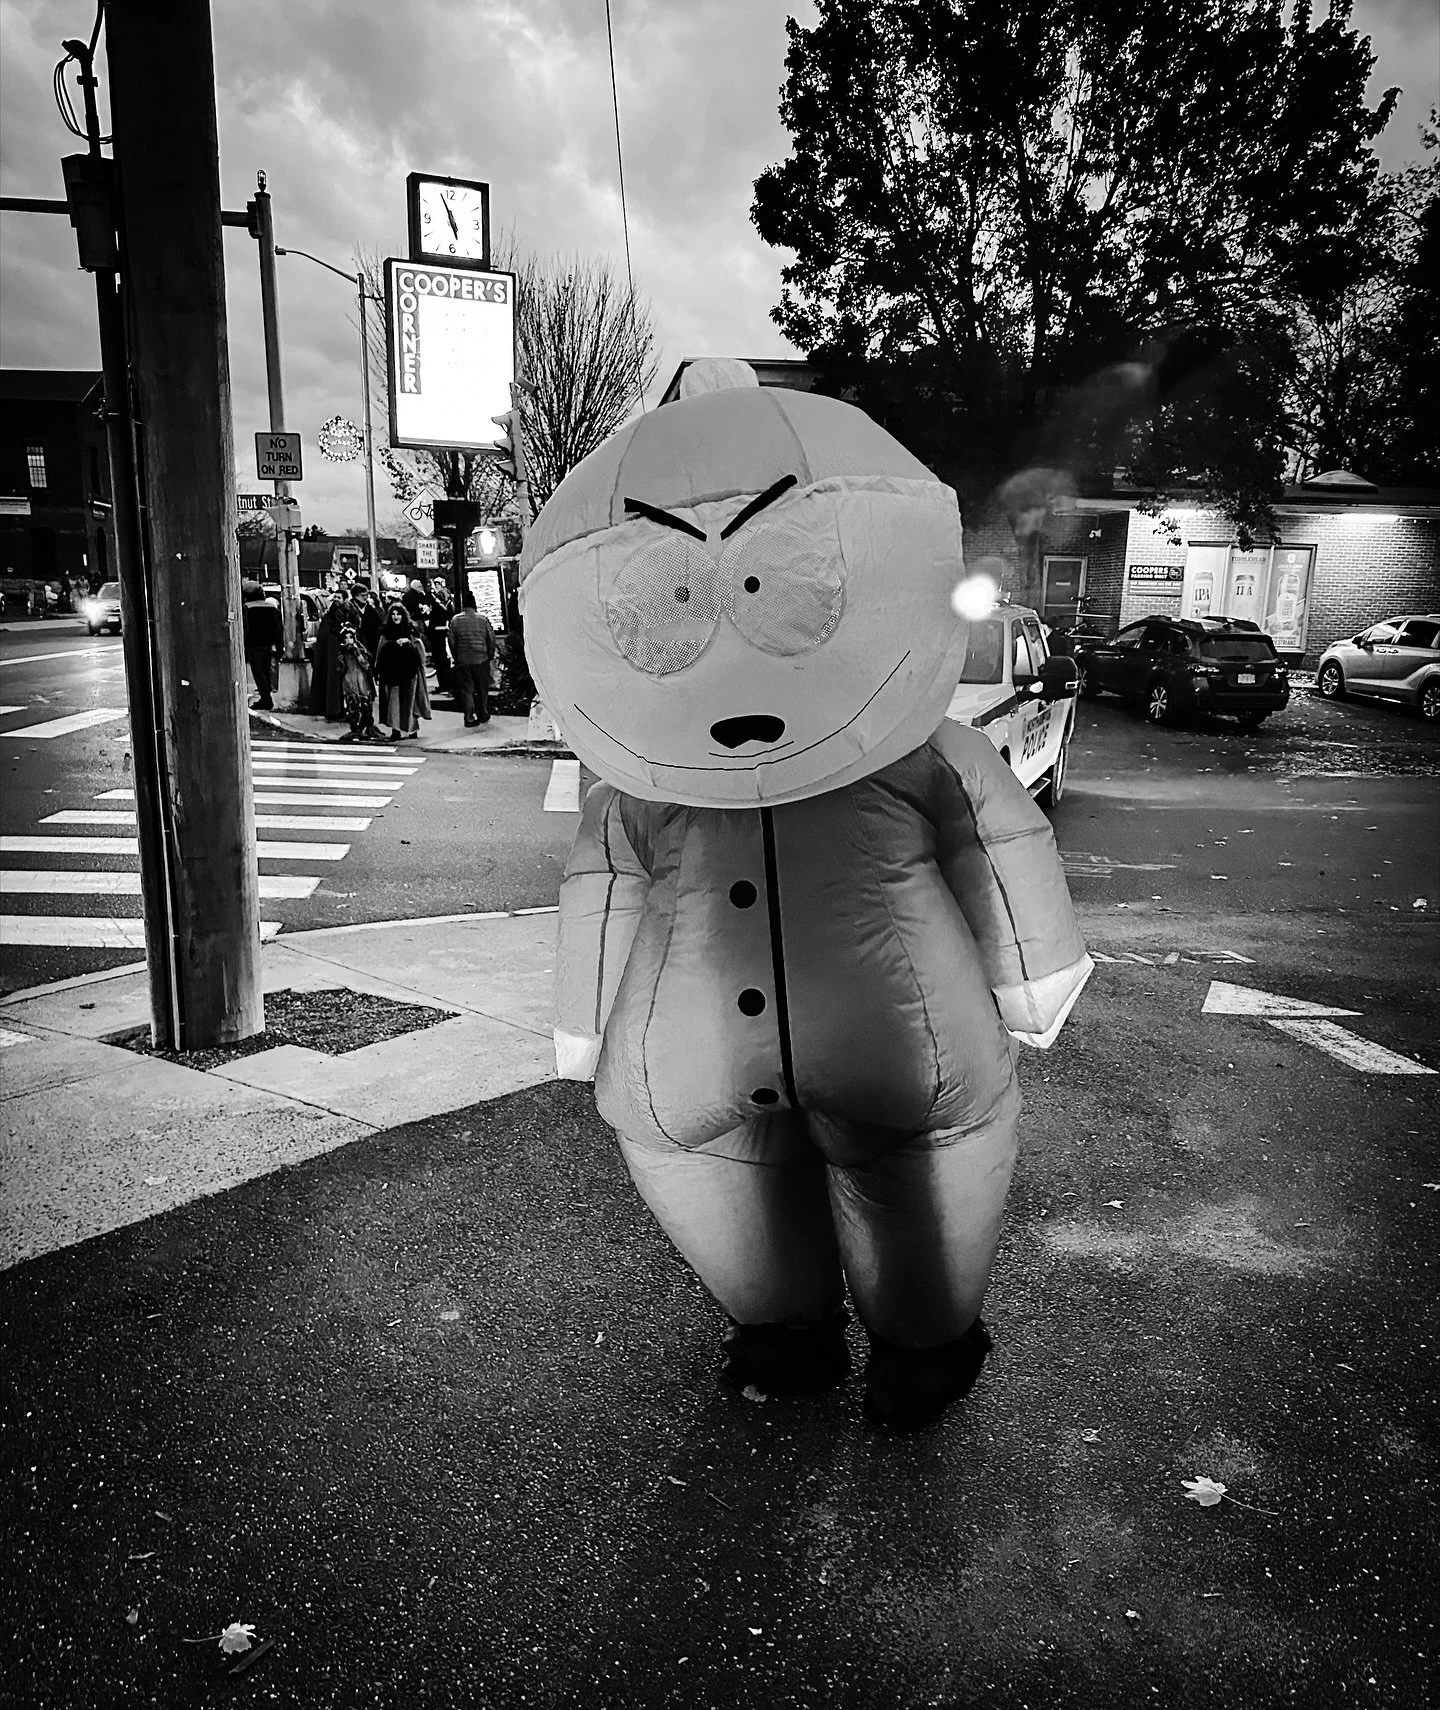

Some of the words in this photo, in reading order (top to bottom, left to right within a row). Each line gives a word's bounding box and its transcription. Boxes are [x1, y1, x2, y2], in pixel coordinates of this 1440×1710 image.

[445, 190, 456, 200] 12
[424, 213, 431, 224] 9
[473, 219, 480, 231] 3
[448, 244, 456, 254] 6
[399, 271, 506, 303] COOPER'S
[399, 271, 418, 393] CORNER
[270, 438, 287, 449] NO
[265, 451, 293, 462] TURN
[261, 465, 275, 475] ON
[279, 465, 299, 475] RED
[261, 496, 272, 508] St
[1131, 566, 1169, 574] COOPERS
[1194, 588, 1210, 600] IPA
[1020, 723, 1050, 764] POLICE
